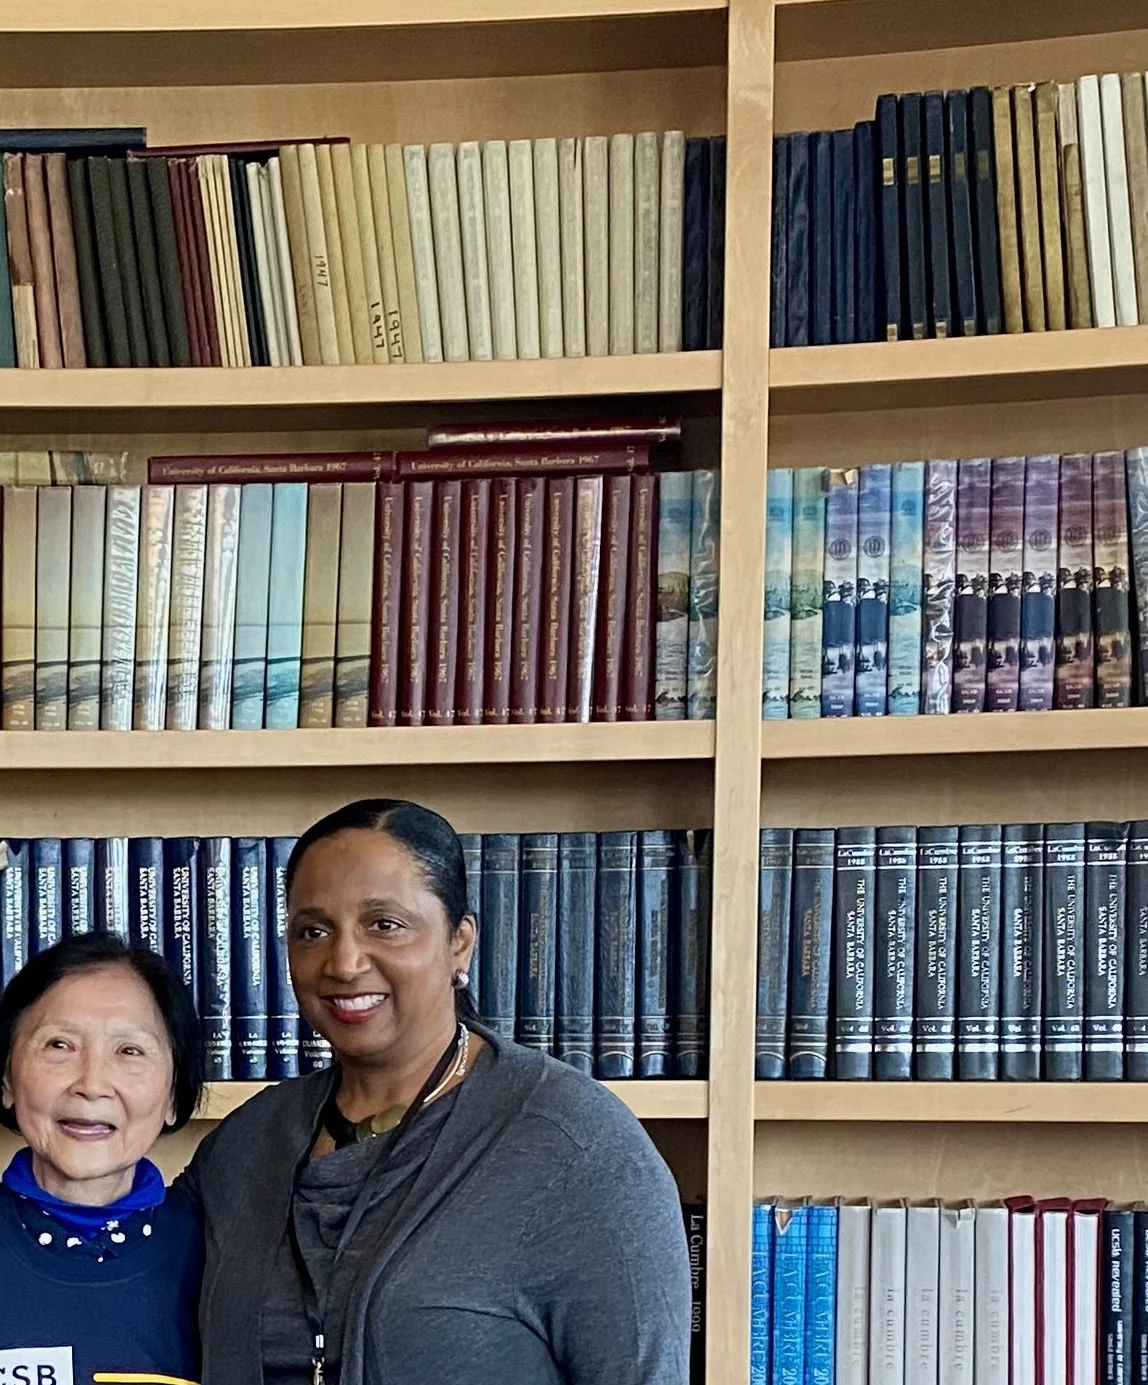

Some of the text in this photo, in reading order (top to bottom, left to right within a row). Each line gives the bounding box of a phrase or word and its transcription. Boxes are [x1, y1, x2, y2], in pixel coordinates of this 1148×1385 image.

[315, 256, 328, 287] 1947
[371, 302, 385, 348] 1947
[388, 310, 402, 358] 1947
[163, 466, 204, 476] University
[411, 461, 453, 472] University
[181, 866, 191, 986] UNIVERSITY OF CALIFORNIA
[846, 911, 855, 978] SANTA BARBARA
[856, 879, 865, 1010] THE UNIVERSITY OF CALIFORNIA
[928, 910, 937, 977] SANTA BARBARA
[938, 877, 947, 1009] THE UNIVERSITY OF CALIFORNIA
[1098, 906, 1107, 976] SANTA BARBARA
[1108, 874, 1117, 1008] THE UNIVERSITY OF CALIFORNIA
[690, 1215, 704, 1231] La
[690, 1236, 704, 1289] Cumbre
[1112, 1261, 1122, 1312] revealed
[886, 1289, 898, 1369] la cumbre
[920, 1289, 933, 1370] la cumbre
[955, 1289, 968, 1370] la cumbre
